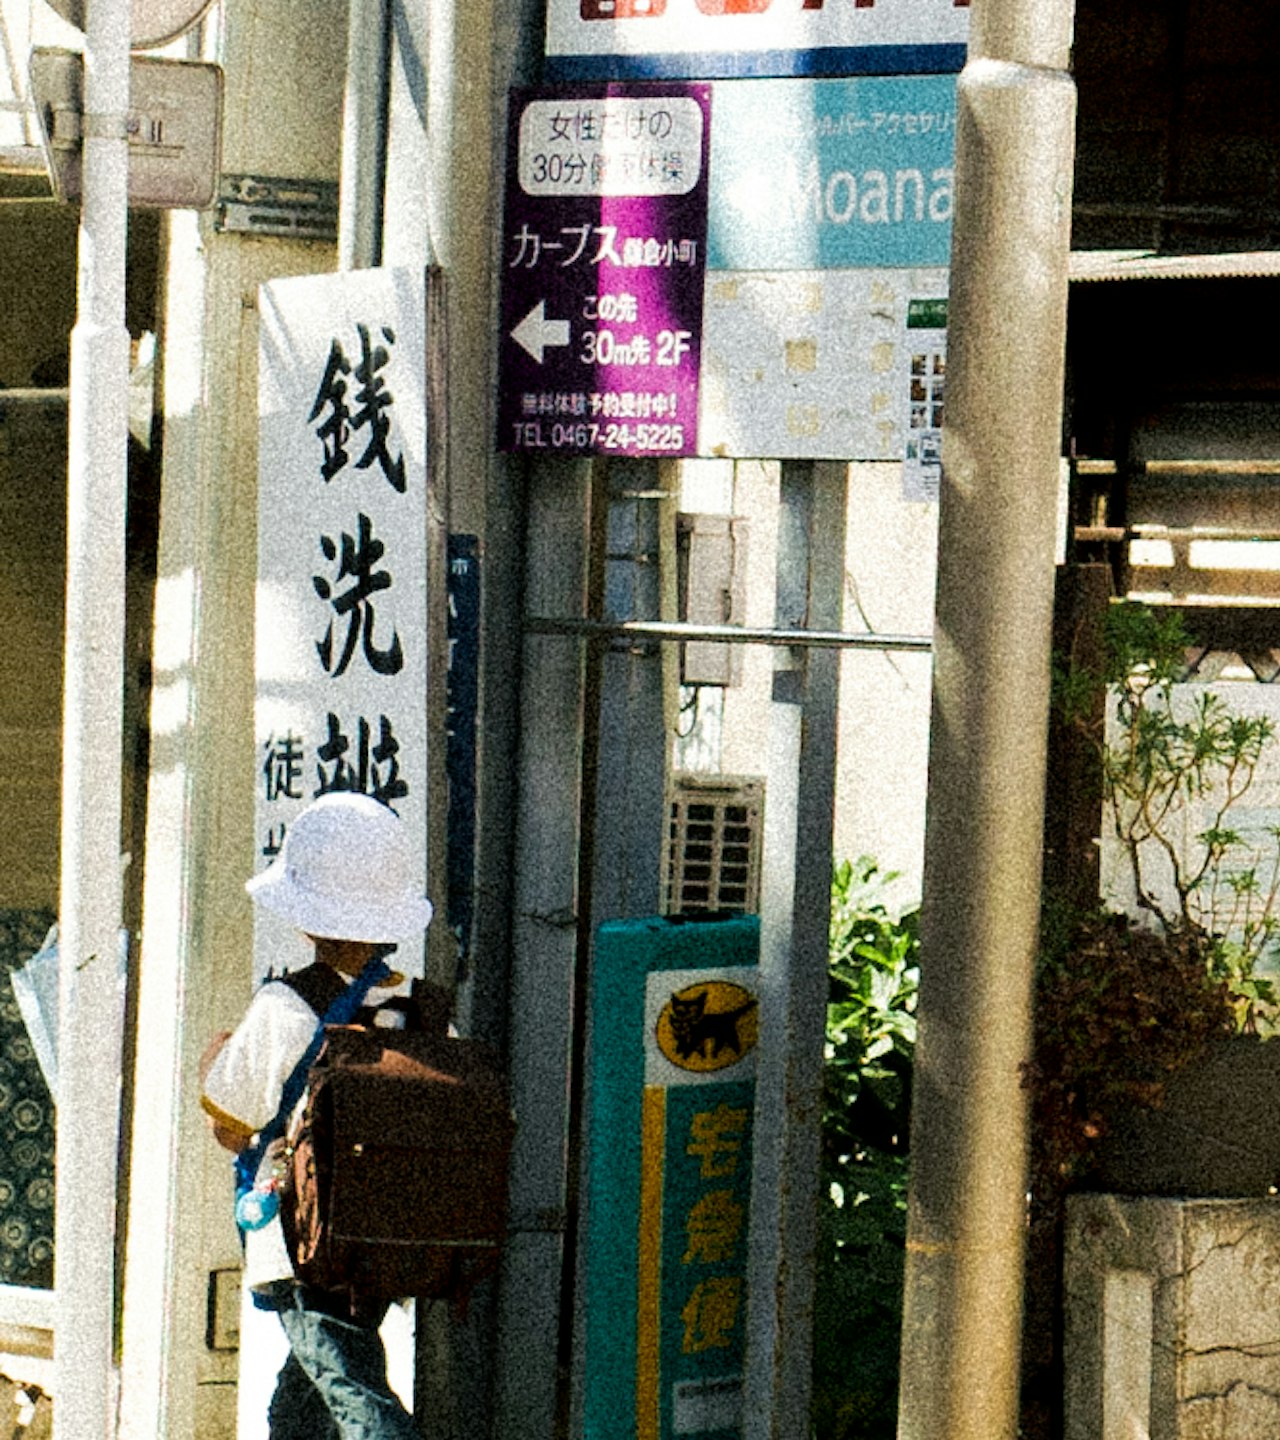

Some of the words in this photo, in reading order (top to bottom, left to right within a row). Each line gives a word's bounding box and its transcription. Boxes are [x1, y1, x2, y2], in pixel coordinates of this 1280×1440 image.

[811, 108, 957, 136] ルバーアクセサリ
[581, 294, 639, 321] この先
[580, 331, 651, 365] 30m先
[655, 330, 692, 365] 2F
[513, 423, 545, 447] TEL
[551, 423, 685, 449] 0467-24-5225
[680, 1104, 748, 1355] 宅急便
